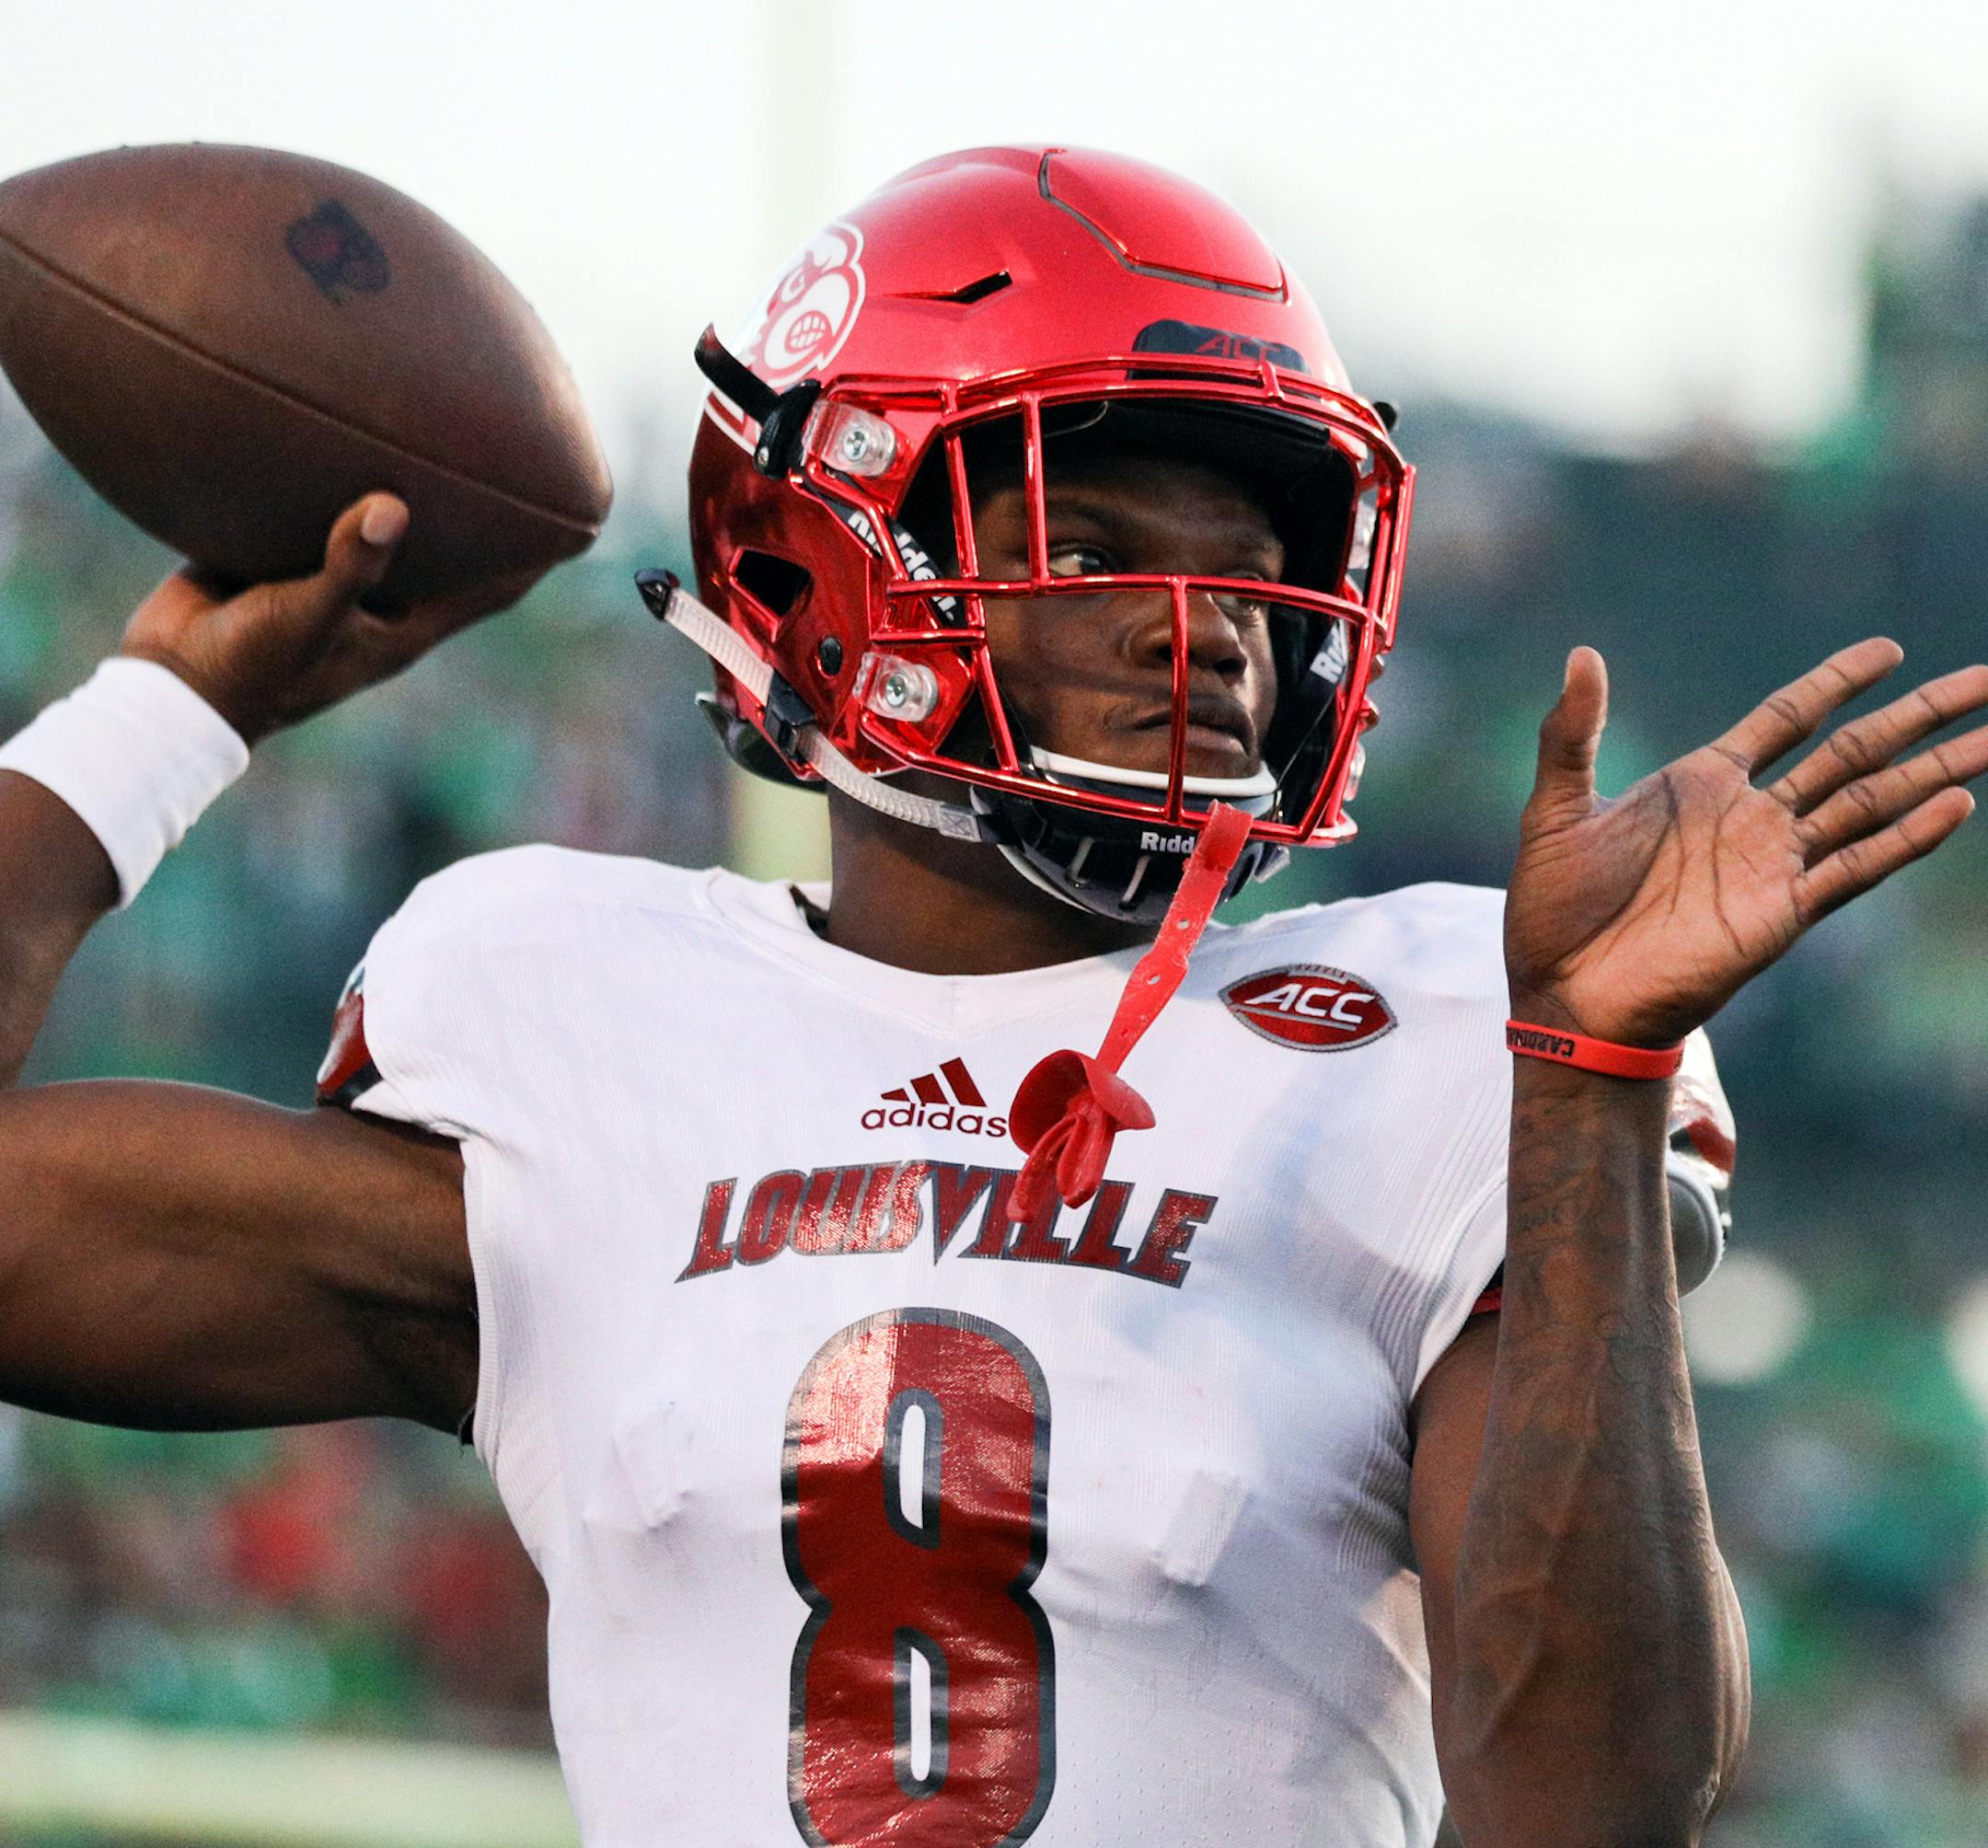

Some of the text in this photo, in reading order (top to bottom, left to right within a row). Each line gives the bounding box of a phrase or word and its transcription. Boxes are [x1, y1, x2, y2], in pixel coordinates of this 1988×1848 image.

[1140, 832, 1196, 854] Ridd
[1244, 983, 1375, 1023] ACC
[861, 1103, 1008, 1138] adidas
[674, 1159, 1219, 1288] LOUISVILLE
[780, 1306, 1058, 1848] 8
